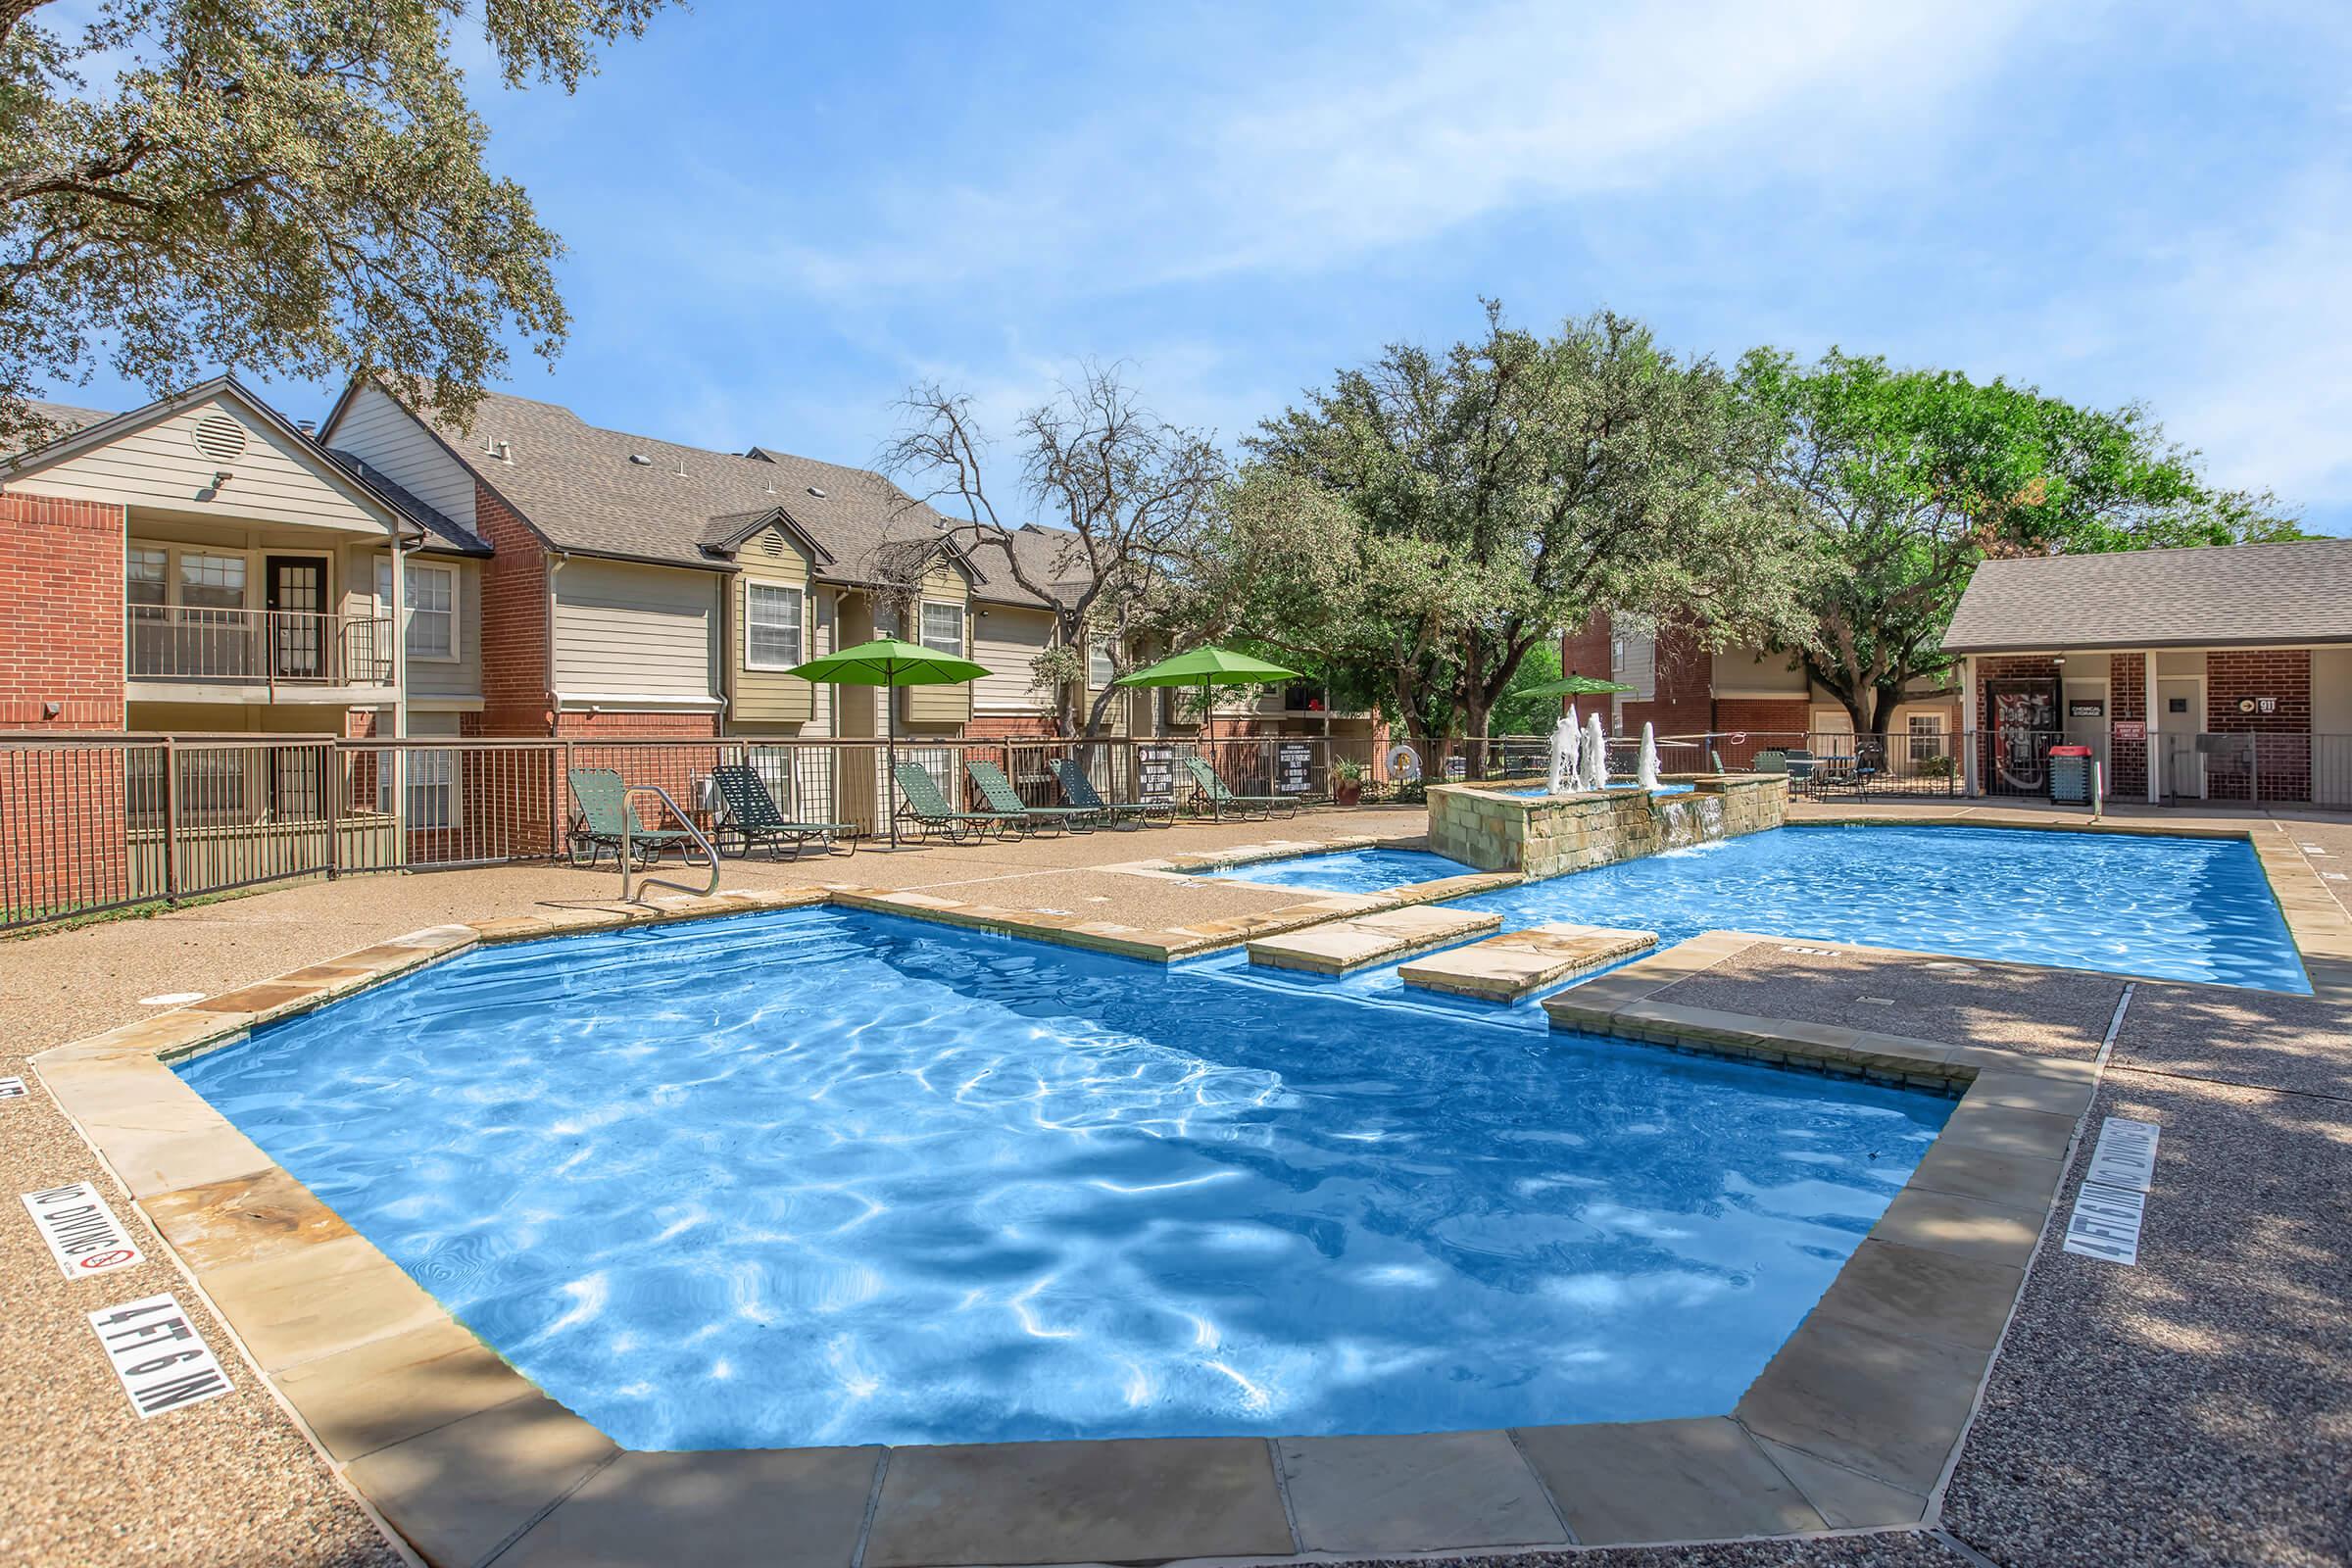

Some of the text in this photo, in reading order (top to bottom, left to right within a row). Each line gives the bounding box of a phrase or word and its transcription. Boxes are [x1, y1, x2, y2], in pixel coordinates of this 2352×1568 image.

[2260, 701, 2276, 710] 911
[1148, 750, 1173, 760] NO DIVING
[1140, 773, 1173, 783] NO LIFEGUARD
[2101, 1131, 2150, 1168] DIVING
[31, 1184, 120, 1255] NO DIVING
[2069, 1184, 2141, 1256] 4 FT 6 IN
[97, 1302, 226, 1413] 4 FT 6 IN
